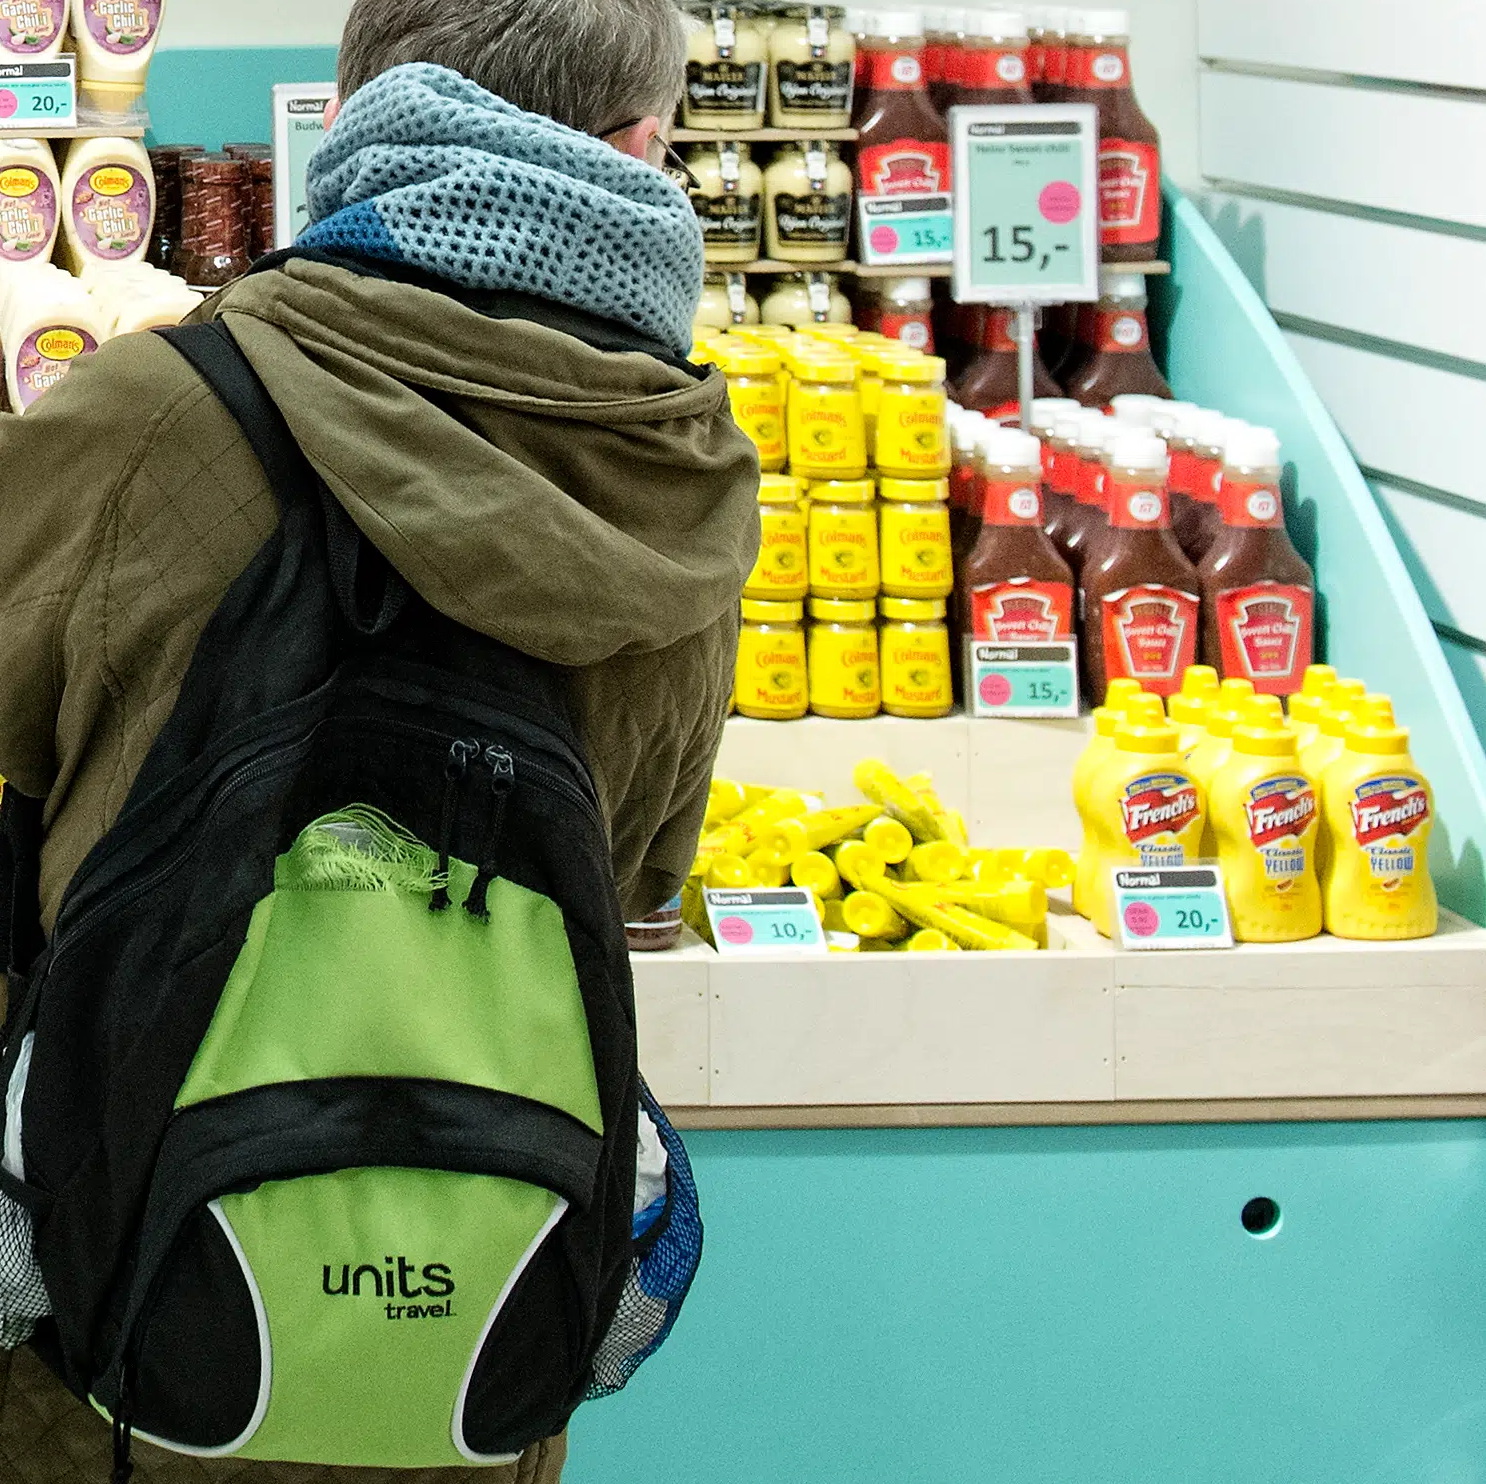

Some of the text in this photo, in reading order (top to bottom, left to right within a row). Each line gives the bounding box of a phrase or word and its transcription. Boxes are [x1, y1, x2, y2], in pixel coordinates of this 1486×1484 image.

[1, 2, 37, 16] Garlic
[98, 1, 135, 16] Garlic
[32, 96, 68, 114] 20,-
[289, 100, 323, 112] Normal
[88, 207, 122, 221] Garlic
[982, 225, 1069, 271] 15,-
[1128, 793, 1196, 831] French's
[1254, 797, 1315, 831] French's
[1359, 797, 1426, 831] French's
[1118, 872, 1160, 887] Normal
[710, 893, 752, 905] Normal
[1176, 909, 1218, 932] 20,-
[771, 922, 812, 941] 10,-
[322, 1255, 456, 1298] units
